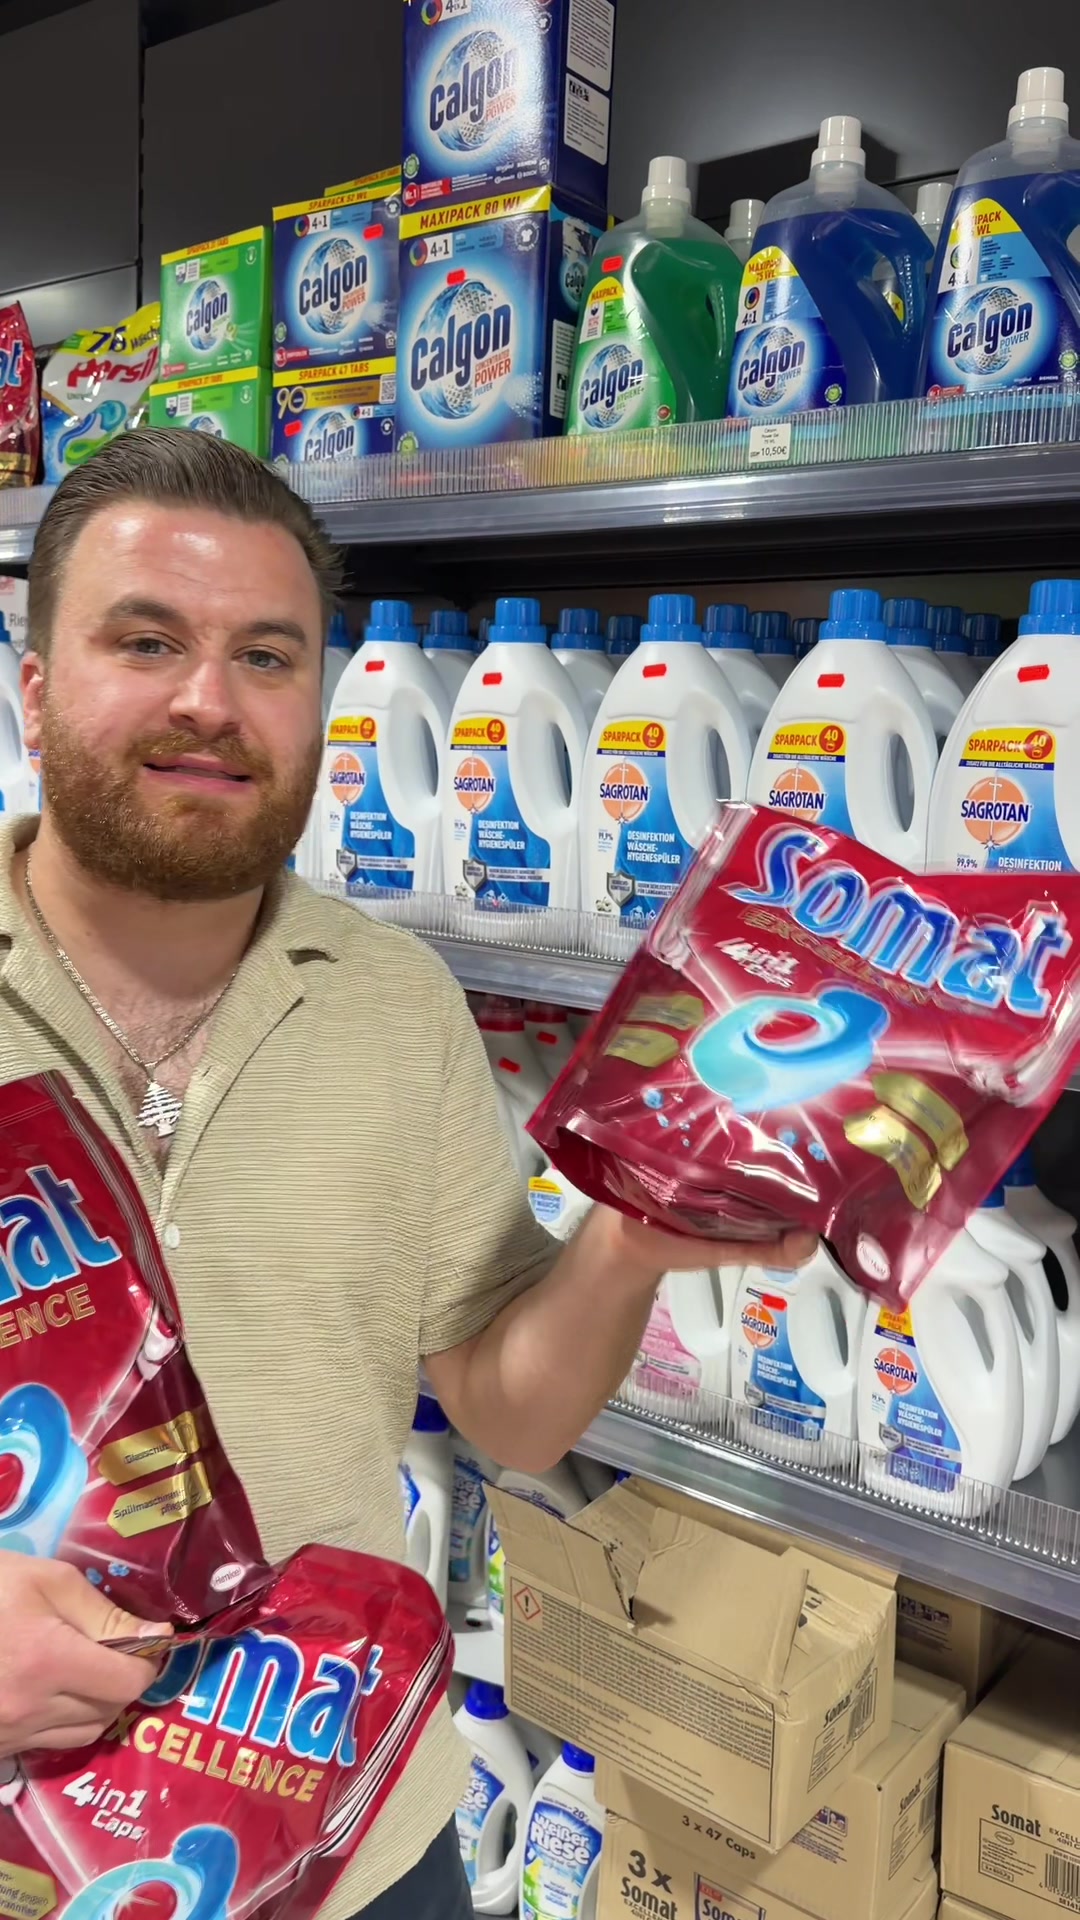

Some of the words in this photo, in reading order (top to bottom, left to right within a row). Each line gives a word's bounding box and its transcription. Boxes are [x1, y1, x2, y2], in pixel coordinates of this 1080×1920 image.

[430, 49, 517, 131] Calgon
[420, 204, 482, 229] MAXIPACK
[484, 200, 499, 215] 80
[976, 224, 991, 235] WL
[299, 254, 367, 316] Calgon
[566, 272, 585, 292] Calgo
[186, 292, 228, 336] Calgon
[947, 302, 1033, 358] Calgon
[1000, 331, 1030, 348] POWER
[411, 304, 511, 392] Calgon
[67, 346, 159, 388] Persil
[299, 366, 337, 381] SPARPACK
[338, 365, 348, 375] 47
[350, 362, 369, 374] TABS
[475, 358, 511, 388] POWER
[738, 340, 805, 391] Calgon
[777, 368, 801, 383] POWER
[580, 359, 643, 410] Calgon
[305, 425, 354, 462] Calgon
[761, 446, 787, 456] 10,50€
[454, 726, 486, 738] SPARPACK
[489, 723, 501, 733] 40
[603, 731, 641, 743] SPARPACK
[646, 727, 659, 738] 40
[775, 734, 817, 746] SPARPACK
[824, 729, 838, 741] 40
[968, 739, 1021, 753] SPARPACK
[1030, 735, 1047, 748] 40
[329, 770, 365, 785] SAGROTAN
[454, 776, 495, 793] SAGROTAN
[600, 783, 649, 801] SAGROTAN
[768, 790, 825, 809] SAGROTAN
[961, 800, 1029, 822] SAGROTAN
[478, 820, 519, 830] DESINFEKTION
[478, 829, 505, 839] WÄSCHE-
[627, 831, 675, 843] DESINFEKTION
[478, 839, 525, 850] HYGIENESPÜLER
[627, 841, 658, 852] WÄSCHE-
[627, 851, 680, 864] HYGIENESPÜLER
[956, 857, 978, 868] 99,9%
[998, 857, 1061, 871] DESINFEKTION
[720, 824, 1071, 1017] Somat
[0, 1165, 122, 1300] at
[741, 1312, 777, 1338] SAGROTAN
[874, 1357, 918, 1383] SAGROTAN
[140, 1628, 384, 1767] mat
[824, 1689, 852, 1728] Somat
[108, 1713, 325, 1803] XCELLENCE
[63, 1771, 148, 1819] 4in1
[92, 1810, 146, 1842] Caps
[534, 1812, 589, 1847] Weißer
[991, 1804, 1041, 1837] Somat
[531, 1821, 591, 1865] Riese
[682, 1815, 690, 1827] 3
[694, 1823, 702, 1833] x
[705, 1827, 722, 1841] 47
[726, 1837, 756, 1860] Caps
[628, 1850, 646, 1878] 3
[651, 1868, 673, 1894] x
[621, 1876, 678, 1920] Somat
[702, 1899, 742, 1920] Som
